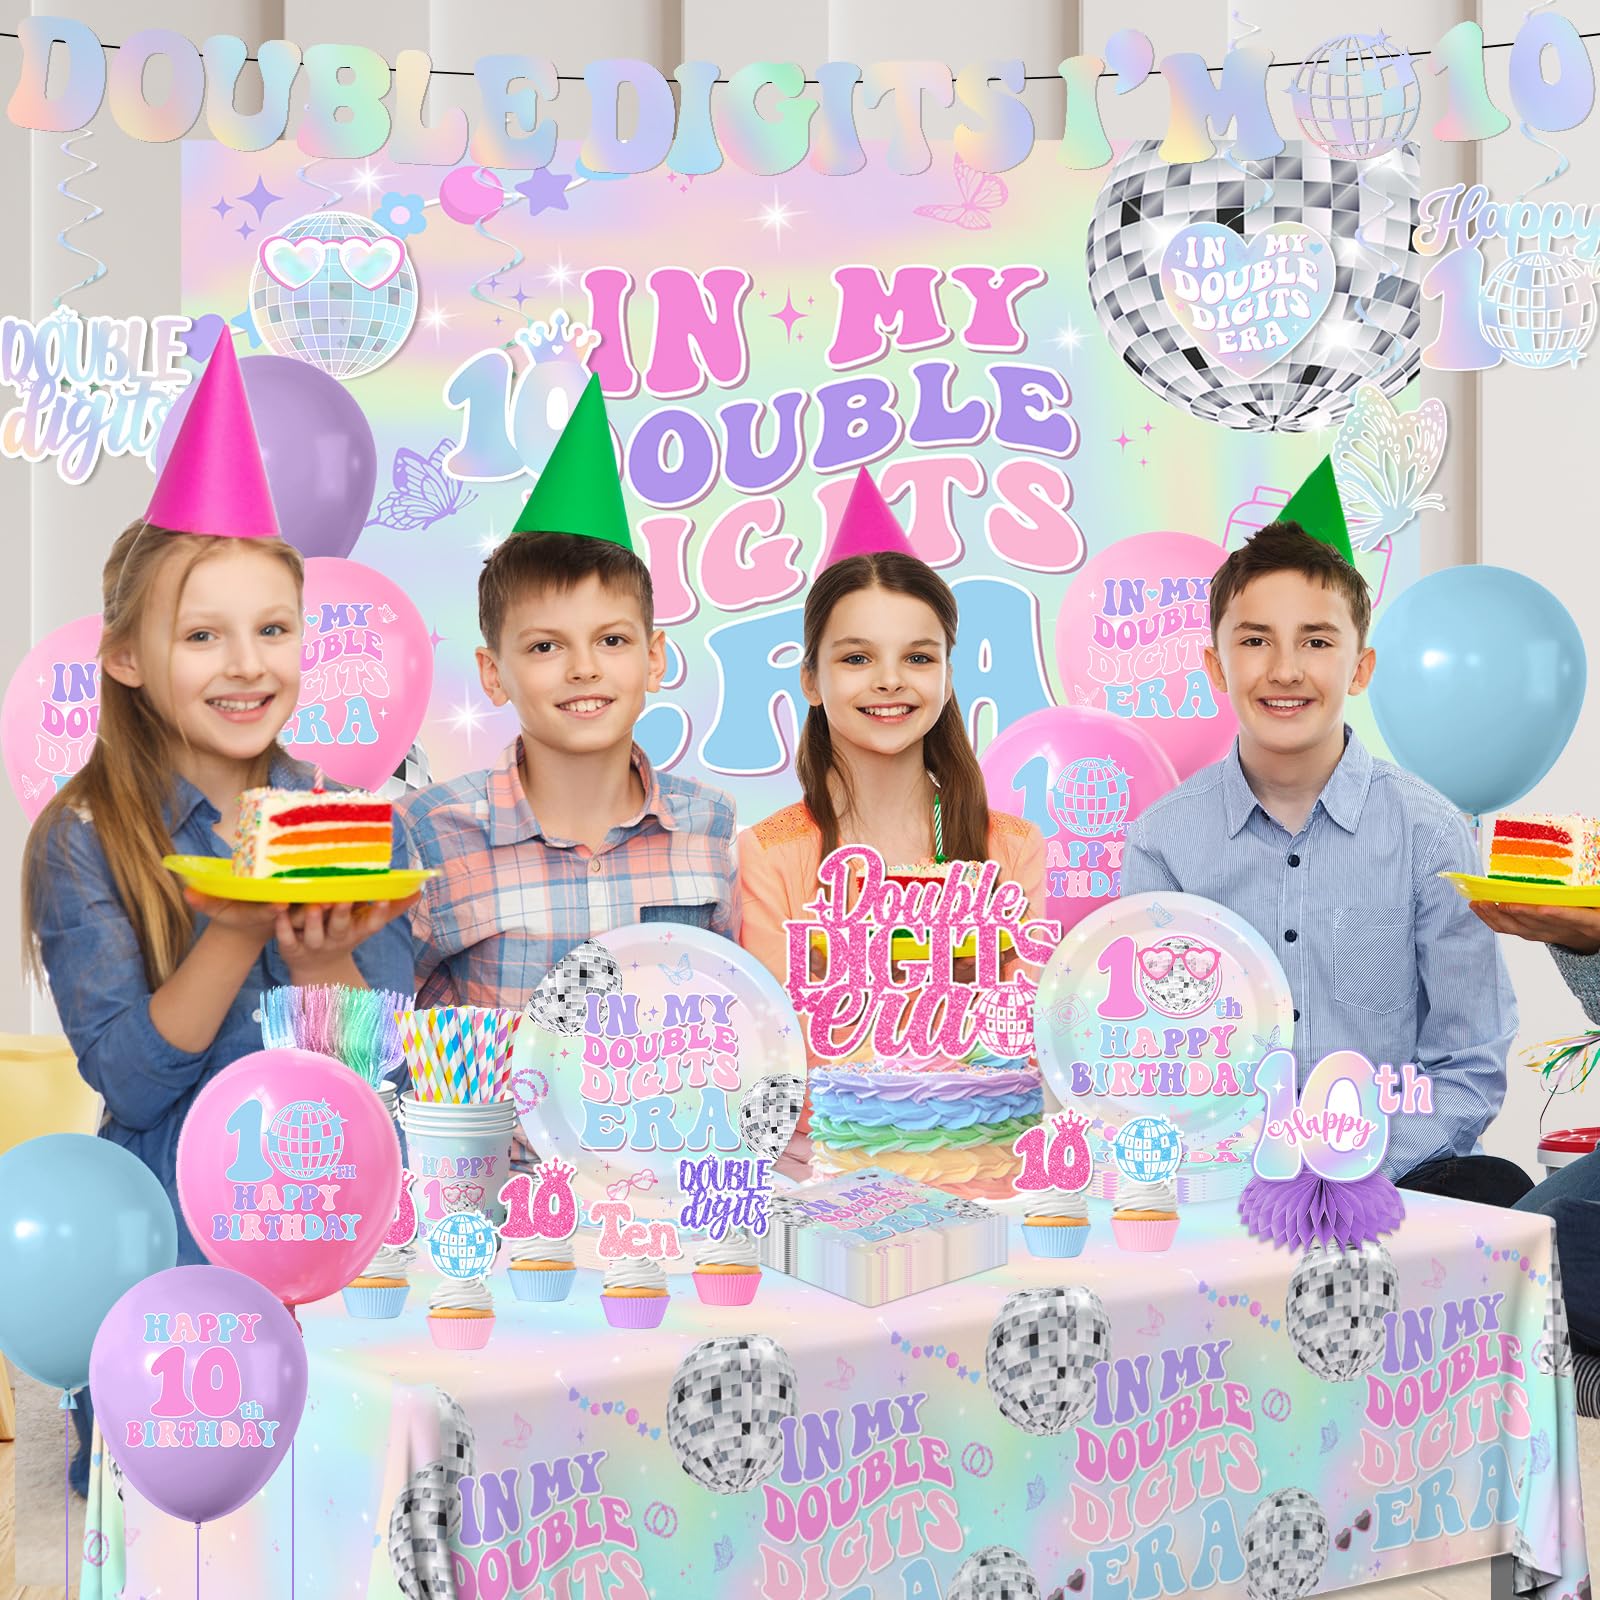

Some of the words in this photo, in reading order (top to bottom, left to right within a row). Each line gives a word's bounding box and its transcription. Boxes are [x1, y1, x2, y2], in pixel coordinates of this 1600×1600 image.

[5, 15, 559, 171] DOUBLE
[579, 57, 1037, 177] DIGITS
[1432, 11, 1597, 143] 10
[1185, 236, 1227, 270] IN
[1264, 234, 1309, 258] MY
[1412, 183, 1600, 263] Happy
[1170, 256, 1320, 306] DOUBLE
[1188, 287, 1312, 333] DIGITS
[0, 317, 190, 382] DOUBLE
[581, 266, 752, 398] IN
[825, 266, 1048, 371] MY
[1216, 320, 1290, 354] ERA
[612, 362, 1081, 508] OUBLE
[319, 603, 373, 633] MY
[1092, 603, 1211, 652] DOUBL
[1102, 578, 1146, 617] IN
[1158, 577, 1212, 608] MY
[51, 662, 97, 703] IN
[1103, 670, 1219, 720] ERA
[818, 844, 1029, 926] Double
[784, 922, 1063, 991] DIGITS
[581, 1024, 739, 1069] DOUBLE
[583, 992, 641, 1039] IN
[662, 992, 738, 1029] MY
[806, 983, 986, 1060] era
[1099, 1024, 1237, 1058] HAPPY
[578, 1050, 742, 1105] DIGITS
[1069, 1061, 1259, 1097] BIRTHDAY
[578, 1086, 743, 1152] ERA
[1252, 1048, 1434, 1182] 10th
[1267, 1108, 1378, 1148] Happy
[421, 1155, 498, 1178] HAPPY
[678, 1156, 774, 1192] DOUBLE
[1014, 1127, 1091, 1192] 10
[211, 1212, 363, 1242] BIRTHDAY
[232, 1183, 341, 1211] HAPPY
[499, 1172, 578, 1241] 10
[679, 1189, 773, 1242] digits
[852, 1201, 962, 1243] ERA
[588, 1201, 683, 1259] Ten
[142, 1312, 262, 1344] HAPPY
[1382, 1307, 1437, 1376] IN
[1440, 1292, 1505, 1350] MY
[149, 1345, 265, 1420] 10th
[1093, 1355, 1152, 1428] IN
[1159, 1339, 1233, 1402] MY
[1365, 1333, 1527, 1430] DOUBLE
[125, 1419, 282, 1449] BIRTHDAY
[779, 1409, 843, 1485] IN
[850, 1391, 928, 1458] MY
[1075, 1381, 1257, 1484] DOUBLE
[1358, 1381, 1533, 1487] DIGITS
[457, 1467, 522, 1548] IN
[528, 1450, 608, 1519] MY
[761, 1436, 955, 1544] DOUBLE
[1069, 1432, 1262, 1545] DIGITS
[1370, 1443, 1520, 1553] ERA
[450, 1495, 639, 1600] DOUBLE
[758, 1488, 964, 1600] DIGITS
[1087, 1497, 1249, 1600] ERA
